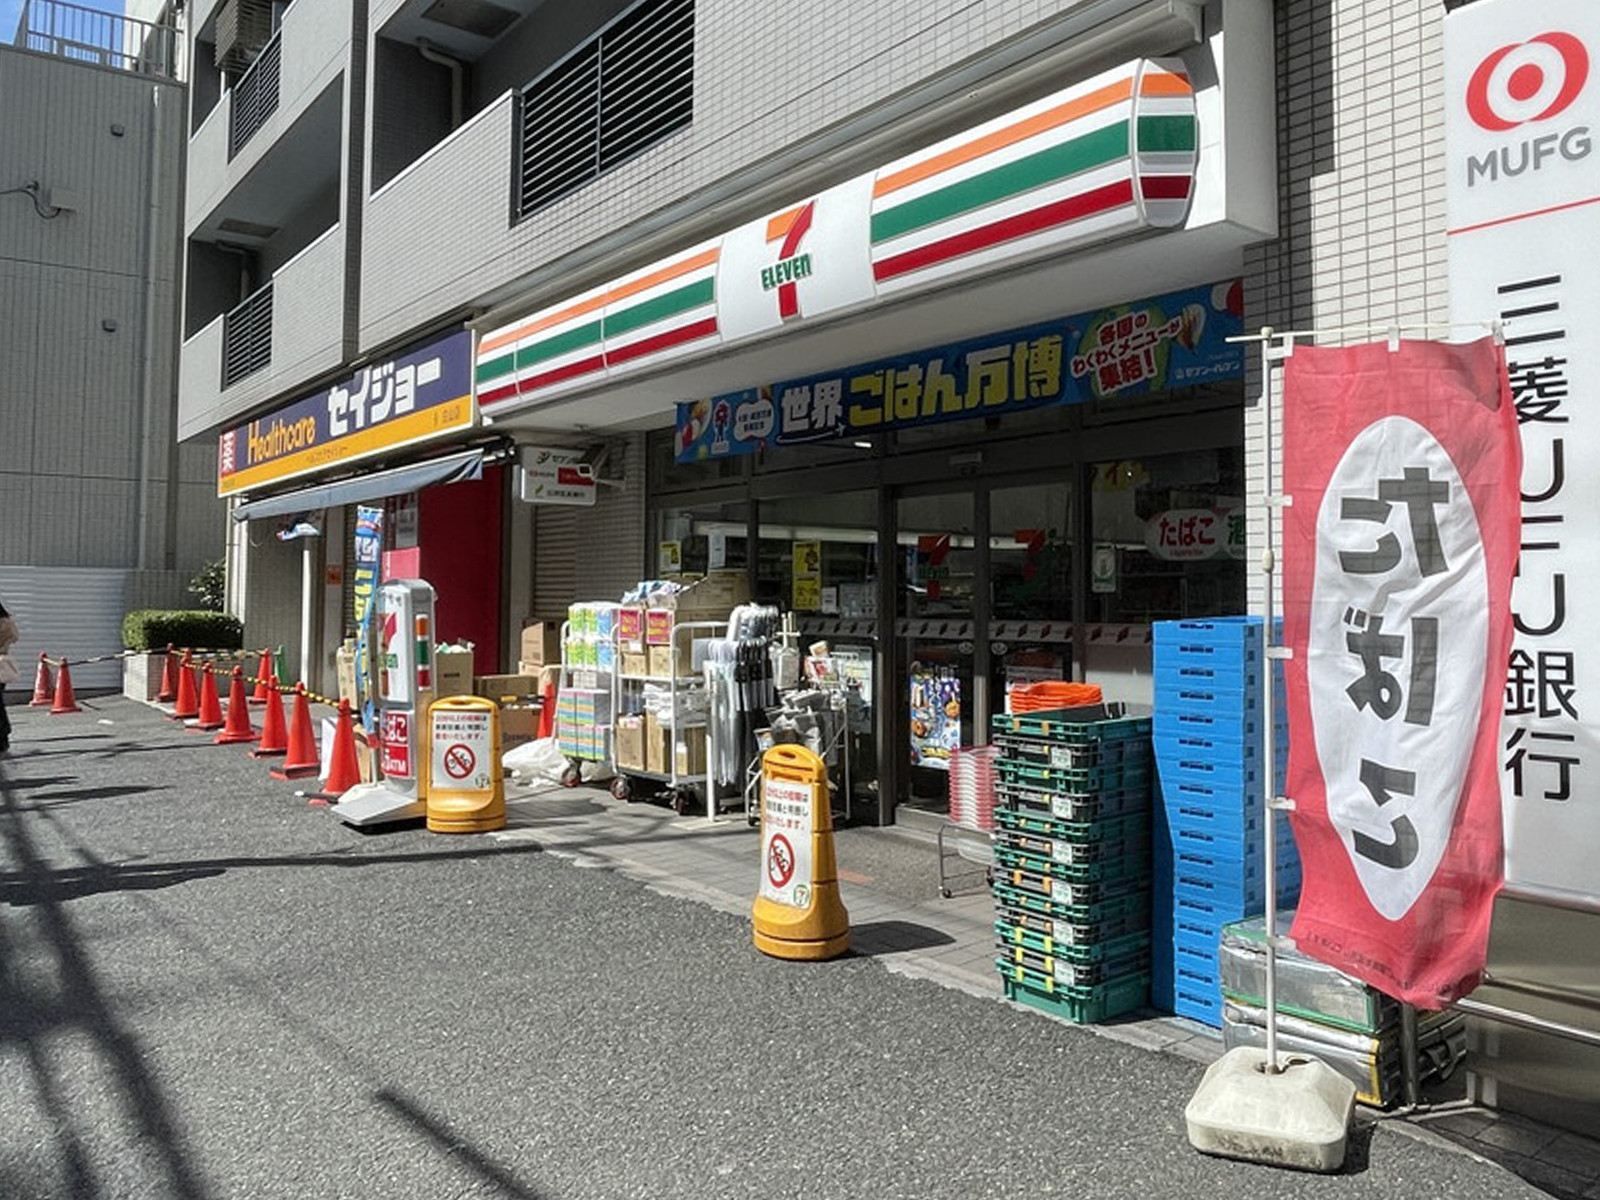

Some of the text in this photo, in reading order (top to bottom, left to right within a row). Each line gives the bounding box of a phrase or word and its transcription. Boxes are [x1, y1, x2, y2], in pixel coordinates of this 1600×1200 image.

[1467, 126, 1592, 187] MUFG
[328, 358, 441, 437] セイジョー
[248, 416, 316, 465] Healthcare
[1159, 516, 1215, 548] たばこ
